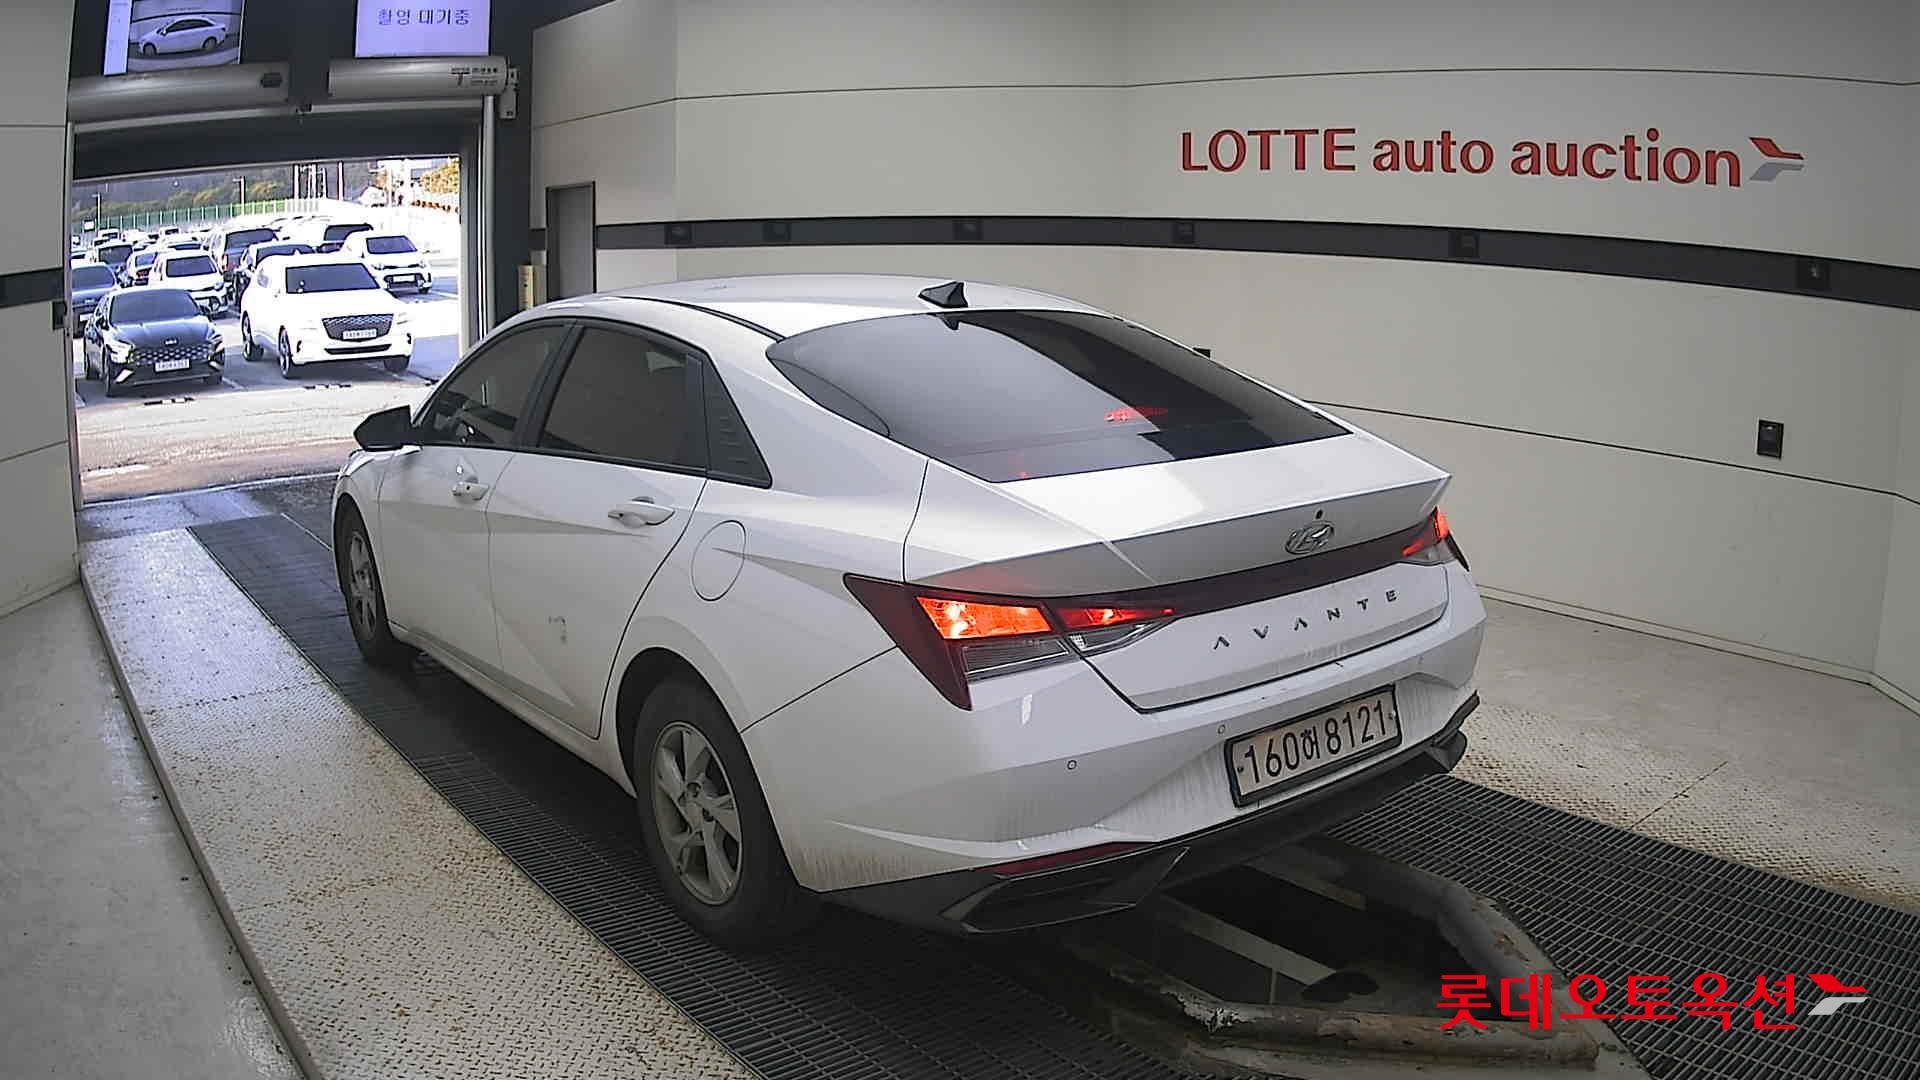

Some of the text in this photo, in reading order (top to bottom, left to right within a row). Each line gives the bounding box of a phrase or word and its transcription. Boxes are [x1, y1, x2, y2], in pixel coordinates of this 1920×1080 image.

[418, 8, 470, 26] 대기중
[1182, 128, 1741, 188] LOTTE auto auction
[1213, 590, 1398, 650] AVANTE
[1244, 699, 1387, 784] 160허8121
